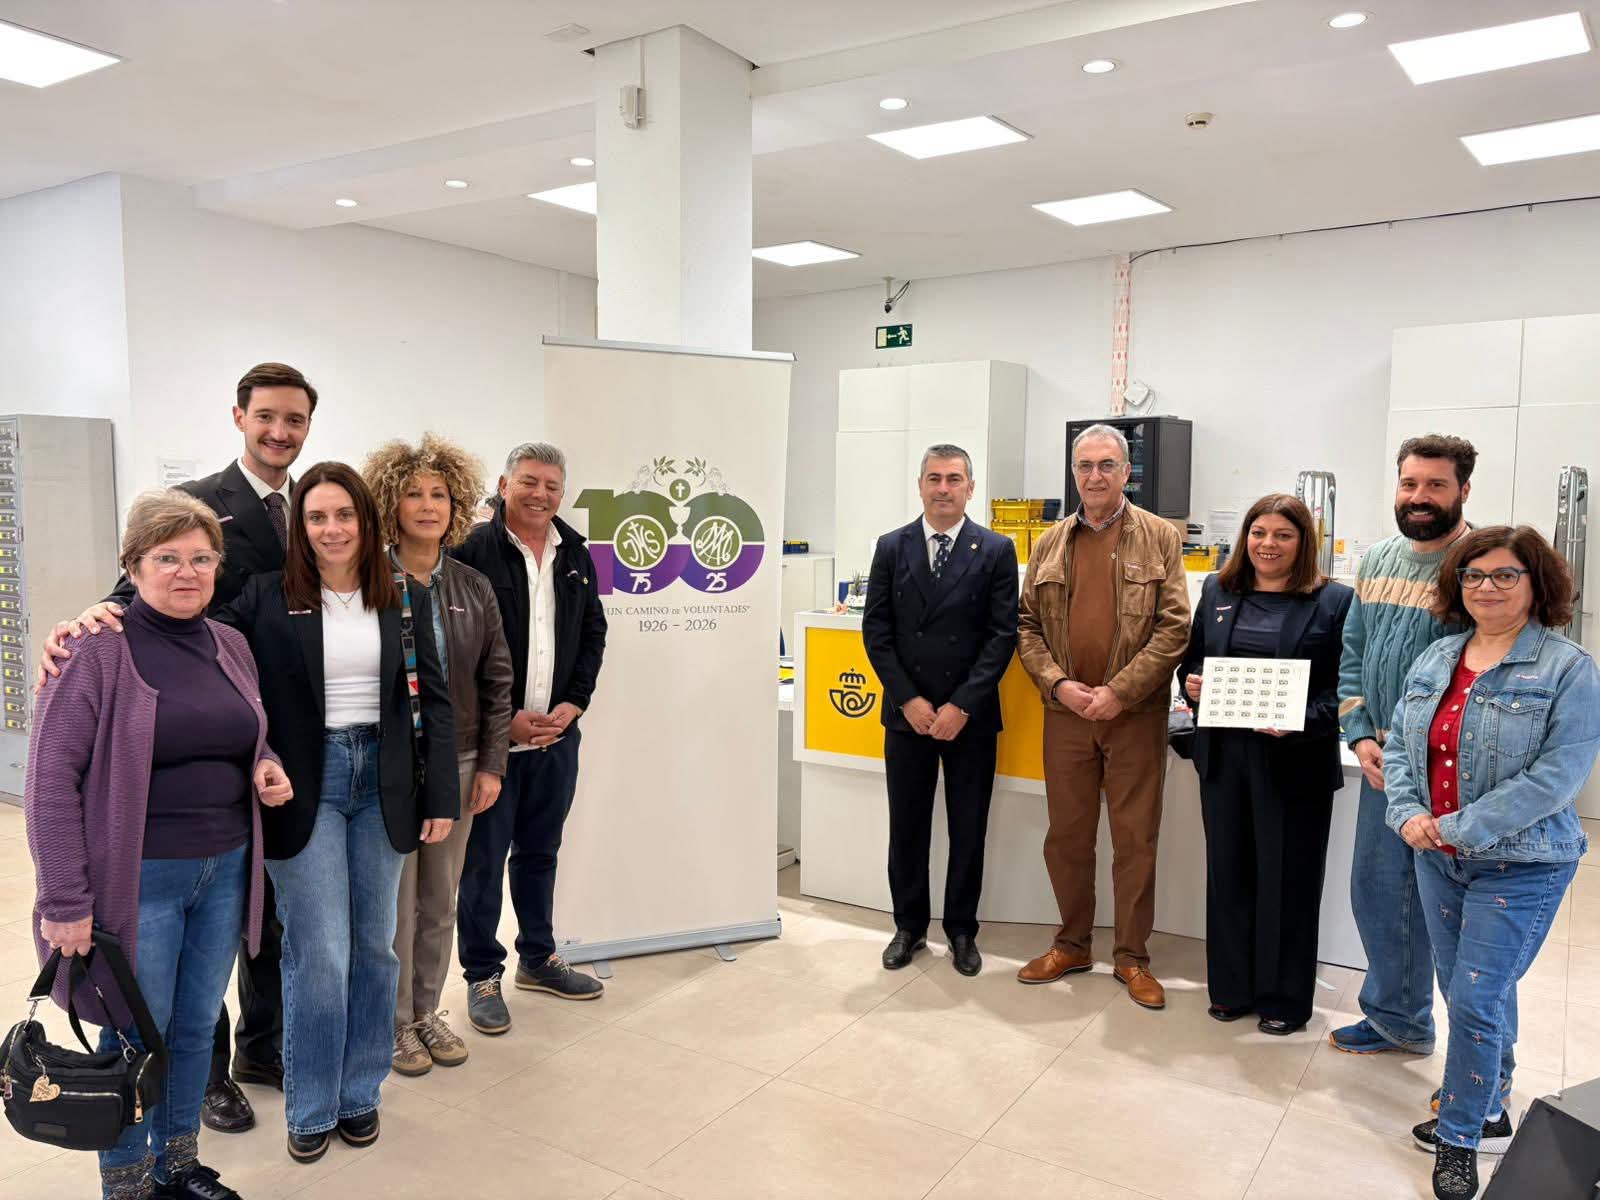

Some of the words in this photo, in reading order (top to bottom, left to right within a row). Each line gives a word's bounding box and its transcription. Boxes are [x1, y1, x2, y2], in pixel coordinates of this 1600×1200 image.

[573, 489, 765, 595] 100
[630, 572, 653, 592] 75
[705, 572, 728, 592] 25
[625, 606, 669, 616] CAMINO
[639, 620, 668, 632] 1926
[685, 619, 717, 631] 2026
